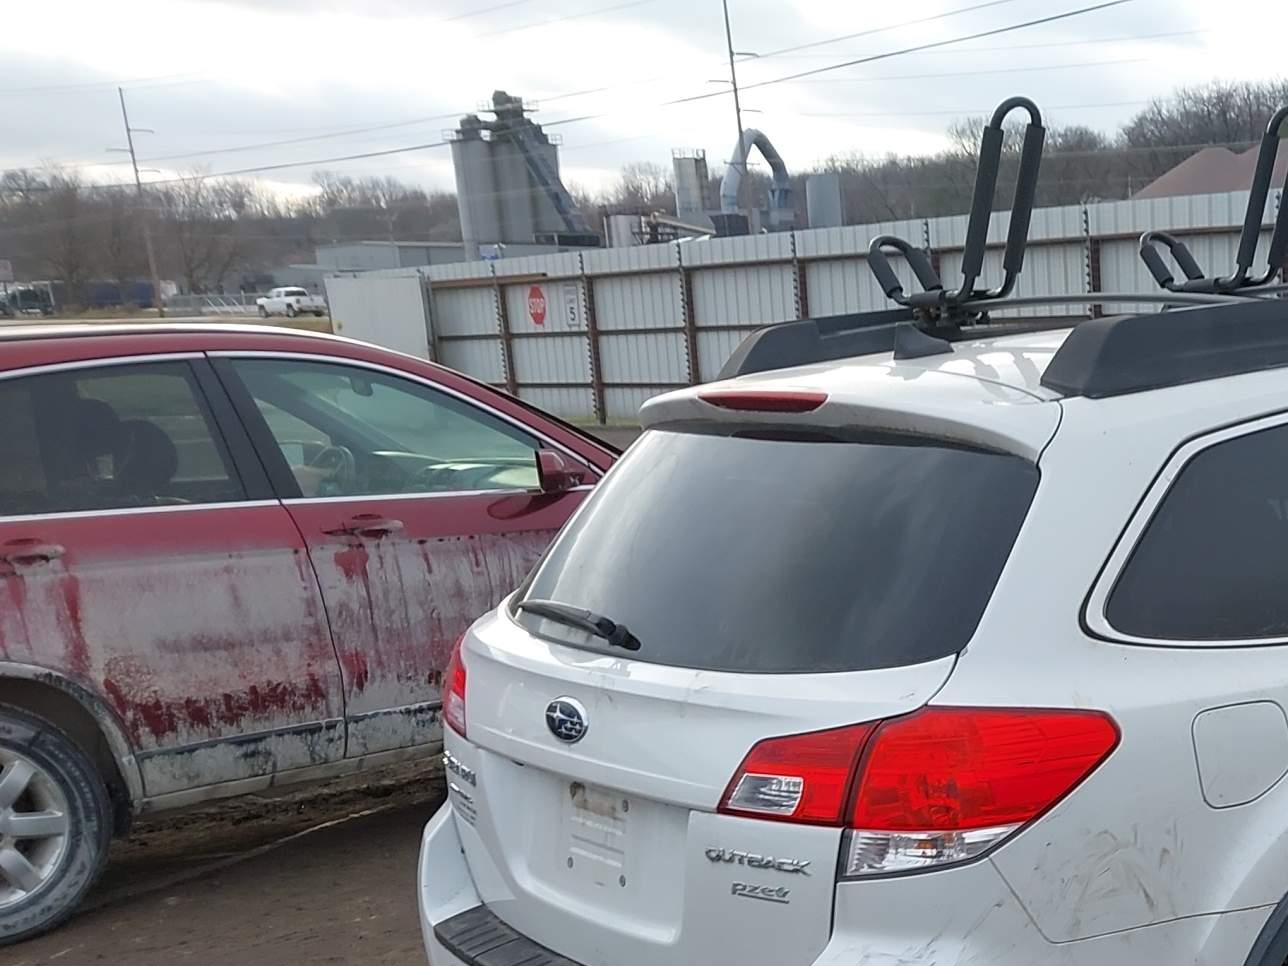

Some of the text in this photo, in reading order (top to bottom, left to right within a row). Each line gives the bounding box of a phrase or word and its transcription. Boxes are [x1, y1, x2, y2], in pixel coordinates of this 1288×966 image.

[528, 298, 545, 313] STOP
[569, 306, 576, 321] 5
[705, 847, 812, 877] OUTBACK
